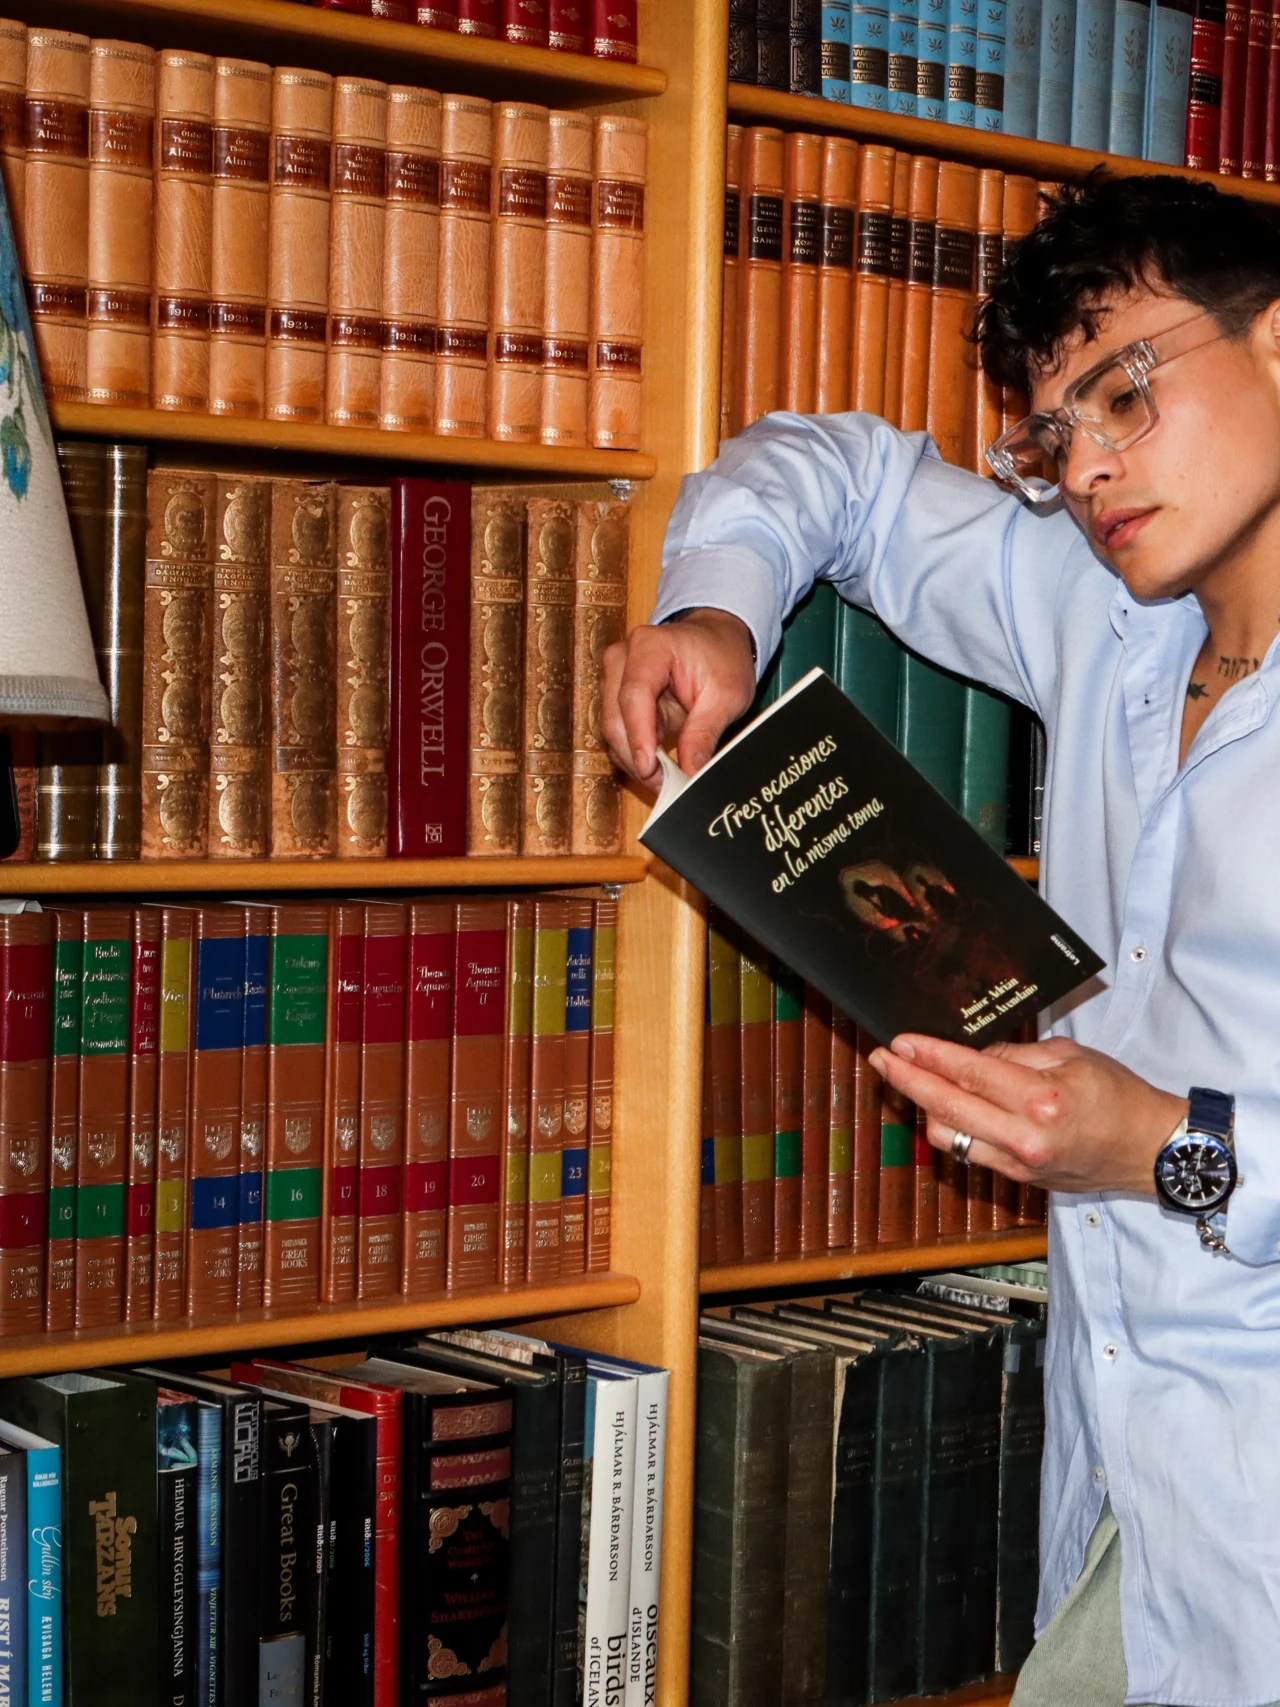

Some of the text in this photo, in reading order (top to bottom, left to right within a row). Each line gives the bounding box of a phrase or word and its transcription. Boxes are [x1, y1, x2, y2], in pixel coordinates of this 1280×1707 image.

[420, 495, 451, 787] GEORGE ORWELL
[708, 733, 840, 838] Tres ocasiones
[763, 774, 849, 853] diferentes
[770, 797, 885, 894] en la misma toma
[959, 975, 1019, 1020] Junior Adrián
[961, 981, 1039, 1037] Medina Avendaño
[212, 1196, 226, 1210] 14
[290, 1188, 303, 1202] 16
[375, 1185, 388, 1198] 18
[423, 1181, 436, 1194] 19
[470, 1174, 486, 1188] 20
[568, 1167, 582, 1180] 23
[281, 1249, 308, 1260] GREAT
[281, 1259, 308, 1269] BOOKS
[611, 1410, 626, 1478] HJÁLMAR
[645, 1403, 658, 1470] HJÁLMAR
[279, 1482, 299, 1623] Great Books
[607, 1495, 625, 1582] BÁRÐARSON
[643, 1487, 658, 1573] BÁRÐARSON
[170, 1478, 186, 1679] HEIMUR HRYGGLEYSINGJANNA
[208, 1447, 218, 1700] ÁRMANN REYNISSON VINJETTUR XIII VIGNETTES
[29, 1524, 62, 1703] Gullin ský ÆVISAGA HELENU
[590, 1636, 599, 1652] of
[630, 1606, 641, 1684] d'ISLANDE
[606, 1631, 628, 1706] birds
[643, 1603, 659, 1706] oiseaux
